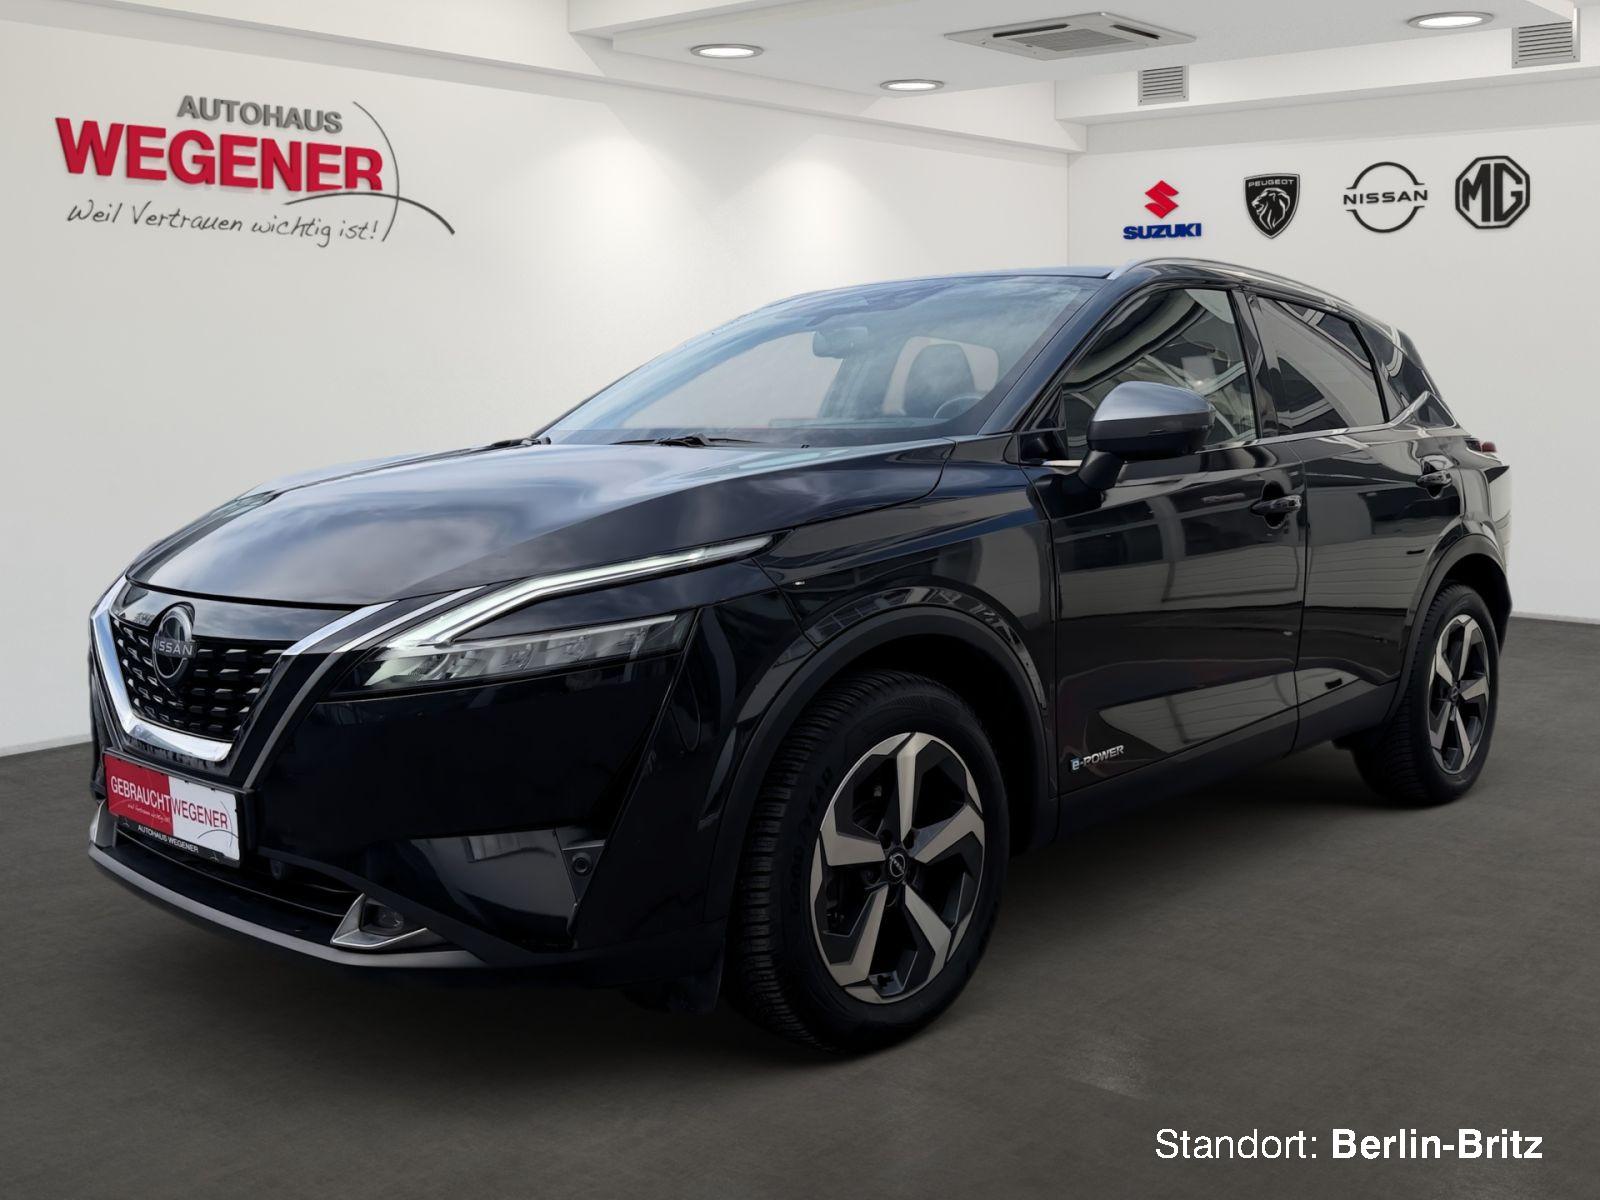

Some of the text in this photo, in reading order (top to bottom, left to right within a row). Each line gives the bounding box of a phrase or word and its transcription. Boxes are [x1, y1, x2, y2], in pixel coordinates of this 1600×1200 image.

[177, 95, 343, 133] AUTOHAUS
[55, 117, 384, 192] WEGENER
[1247, 178, 1295, 188] PEUGEOT
[1343, 189, 1428, 206] NISSAN
[1462, 163, 1523, 222] MG
[67, 199, 379, 248] Weil Vertrauen wichtig ist!
[1123, 223, 1202, 240] SUZUKI
[138, 825, 199, 853] AUTOHAUS WEGENER
